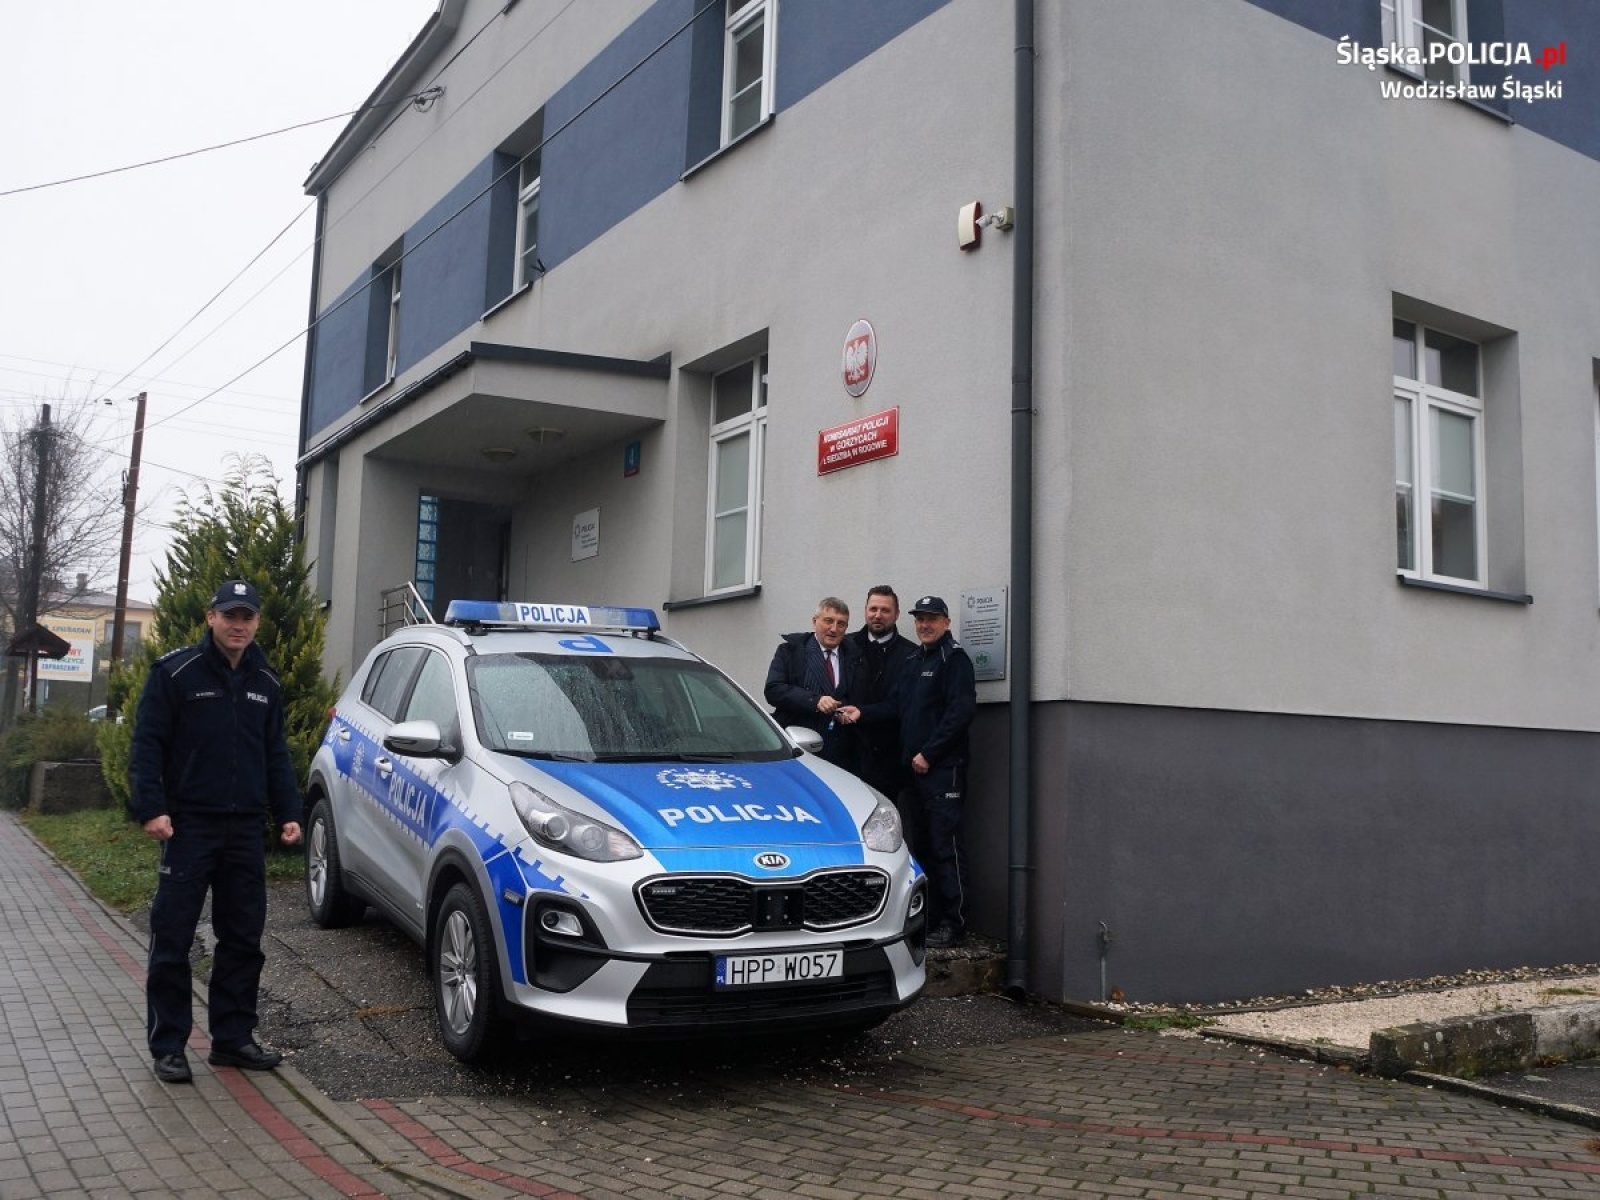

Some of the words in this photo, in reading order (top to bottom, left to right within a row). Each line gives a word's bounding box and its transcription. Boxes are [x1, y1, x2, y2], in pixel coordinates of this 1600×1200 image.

[823, 425, 861, 443] KOMISARIAT
[862, 416, 889, 430] POLICJI
[836, 431, 877, 450] GORZYCACH
[520, 606, 587, 624] POLICJA
[388, 771, 427, 828] POLICJA
[657, 804, 822, 828] POLICJA
[761, 855, 783, 866] KIA
[731, 956, 776, 984] HPP
[784, 954, 838, 981] W057
